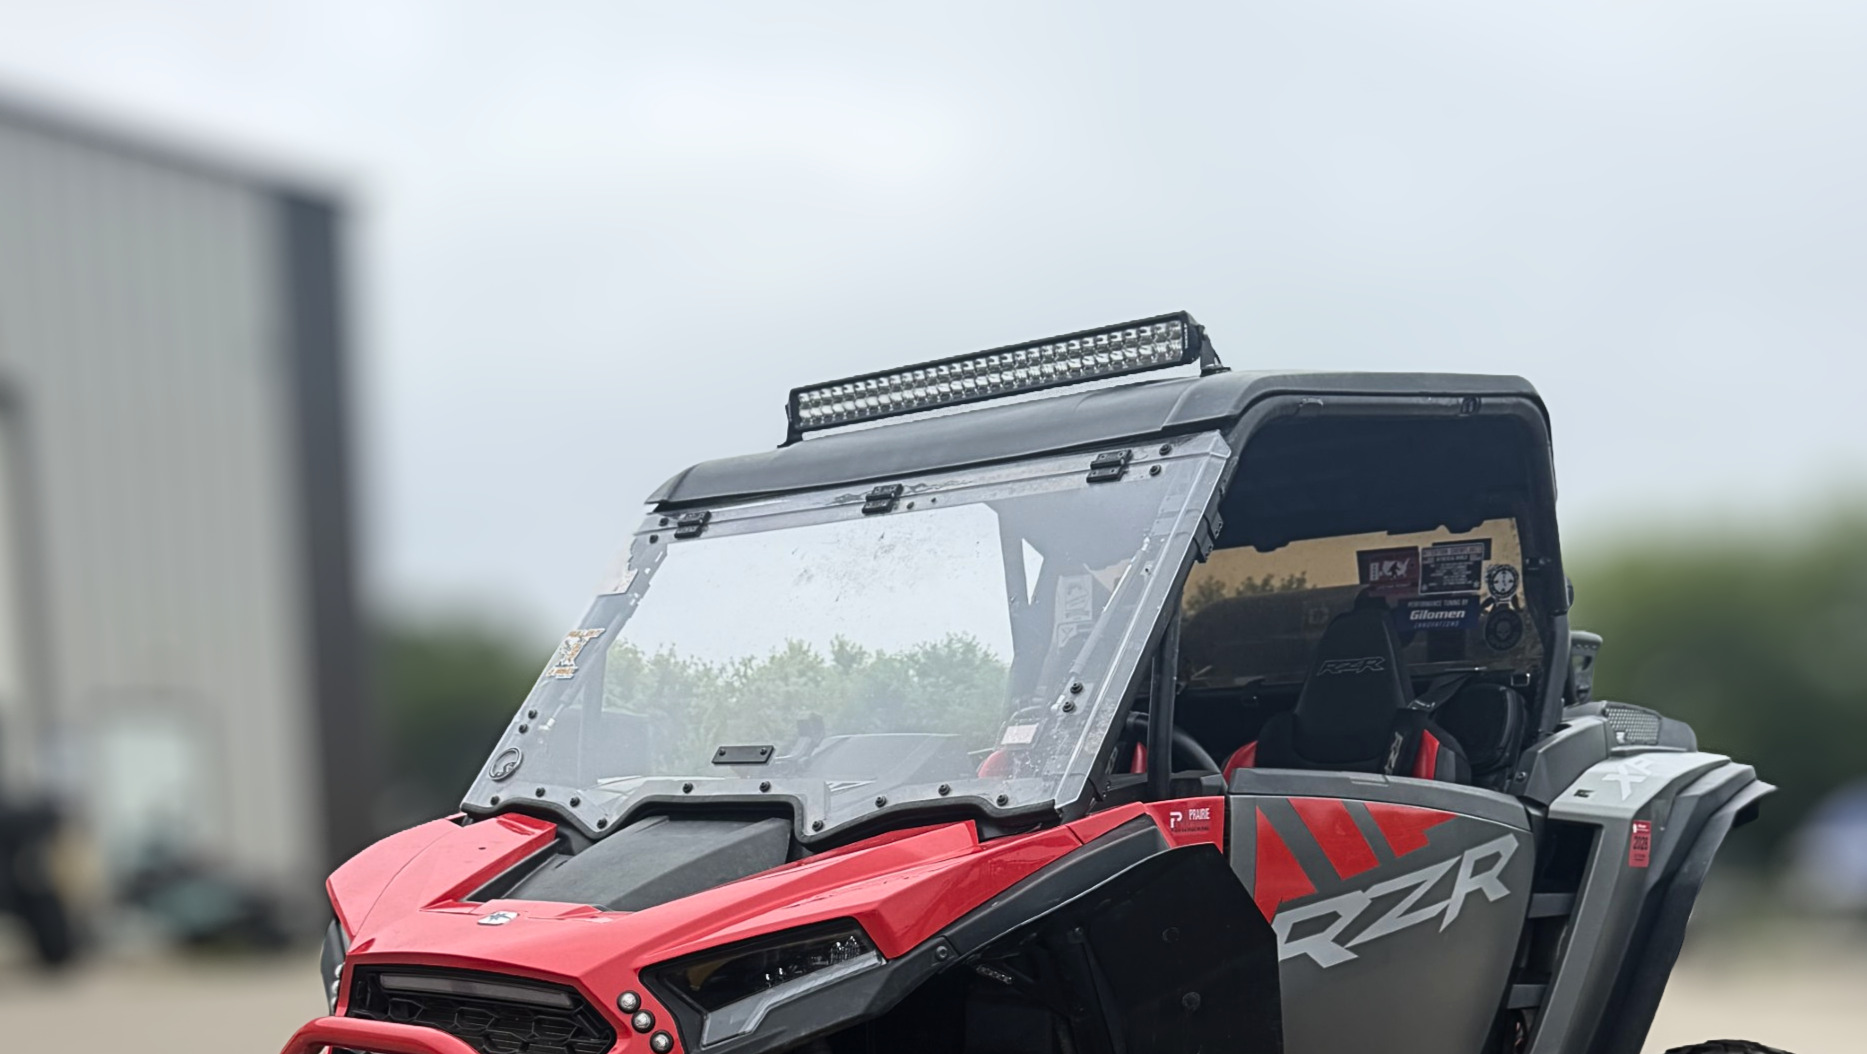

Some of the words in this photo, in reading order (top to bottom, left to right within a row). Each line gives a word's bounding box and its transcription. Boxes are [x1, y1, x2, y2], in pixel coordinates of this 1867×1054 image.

[1409, 609, 1466, 621] Gilomen
[1601, 756, 1655, 802] XP
[1271, 833, 1519, 969] RZR
